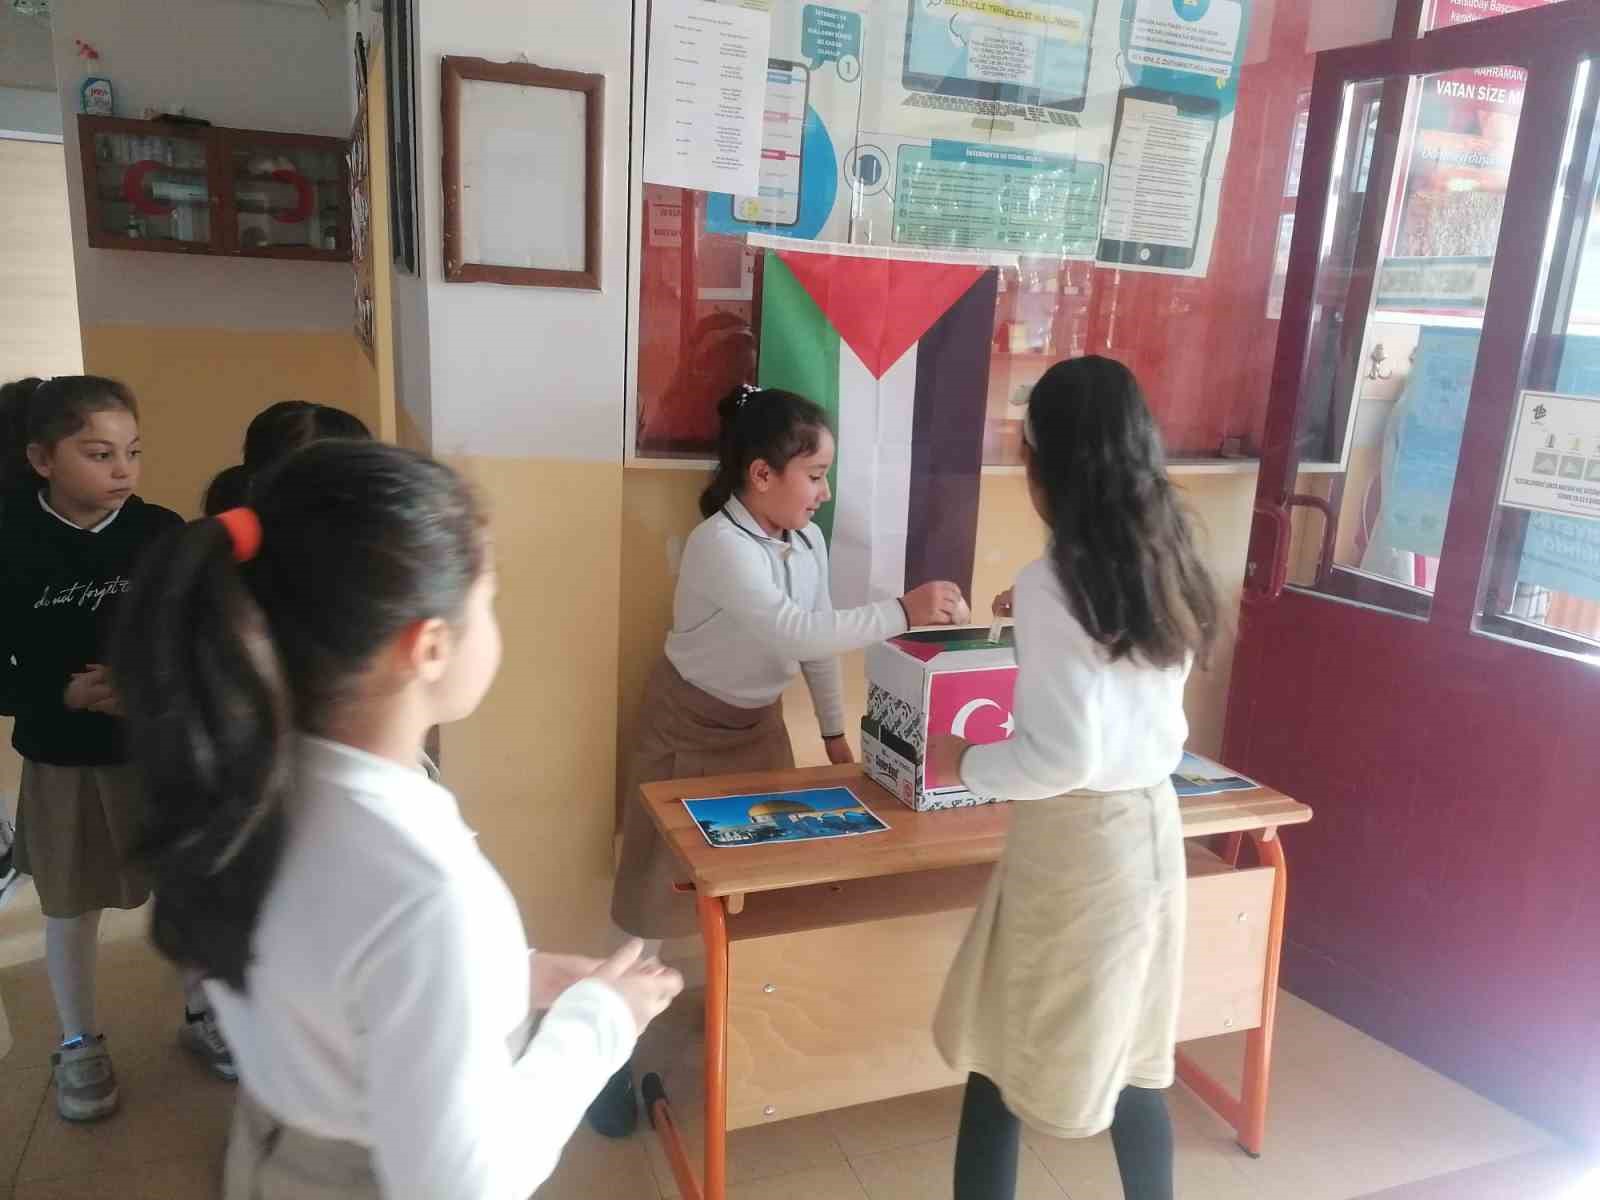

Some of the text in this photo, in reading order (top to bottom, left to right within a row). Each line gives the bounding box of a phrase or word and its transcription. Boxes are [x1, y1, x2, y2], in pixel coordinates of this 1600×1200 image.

[1437, 79, 1475, 98] VATAN
[1478, 84, 1506, 103] SİZE
[33, 585, 50, 609] do
[52, 582, 86, 605] not
